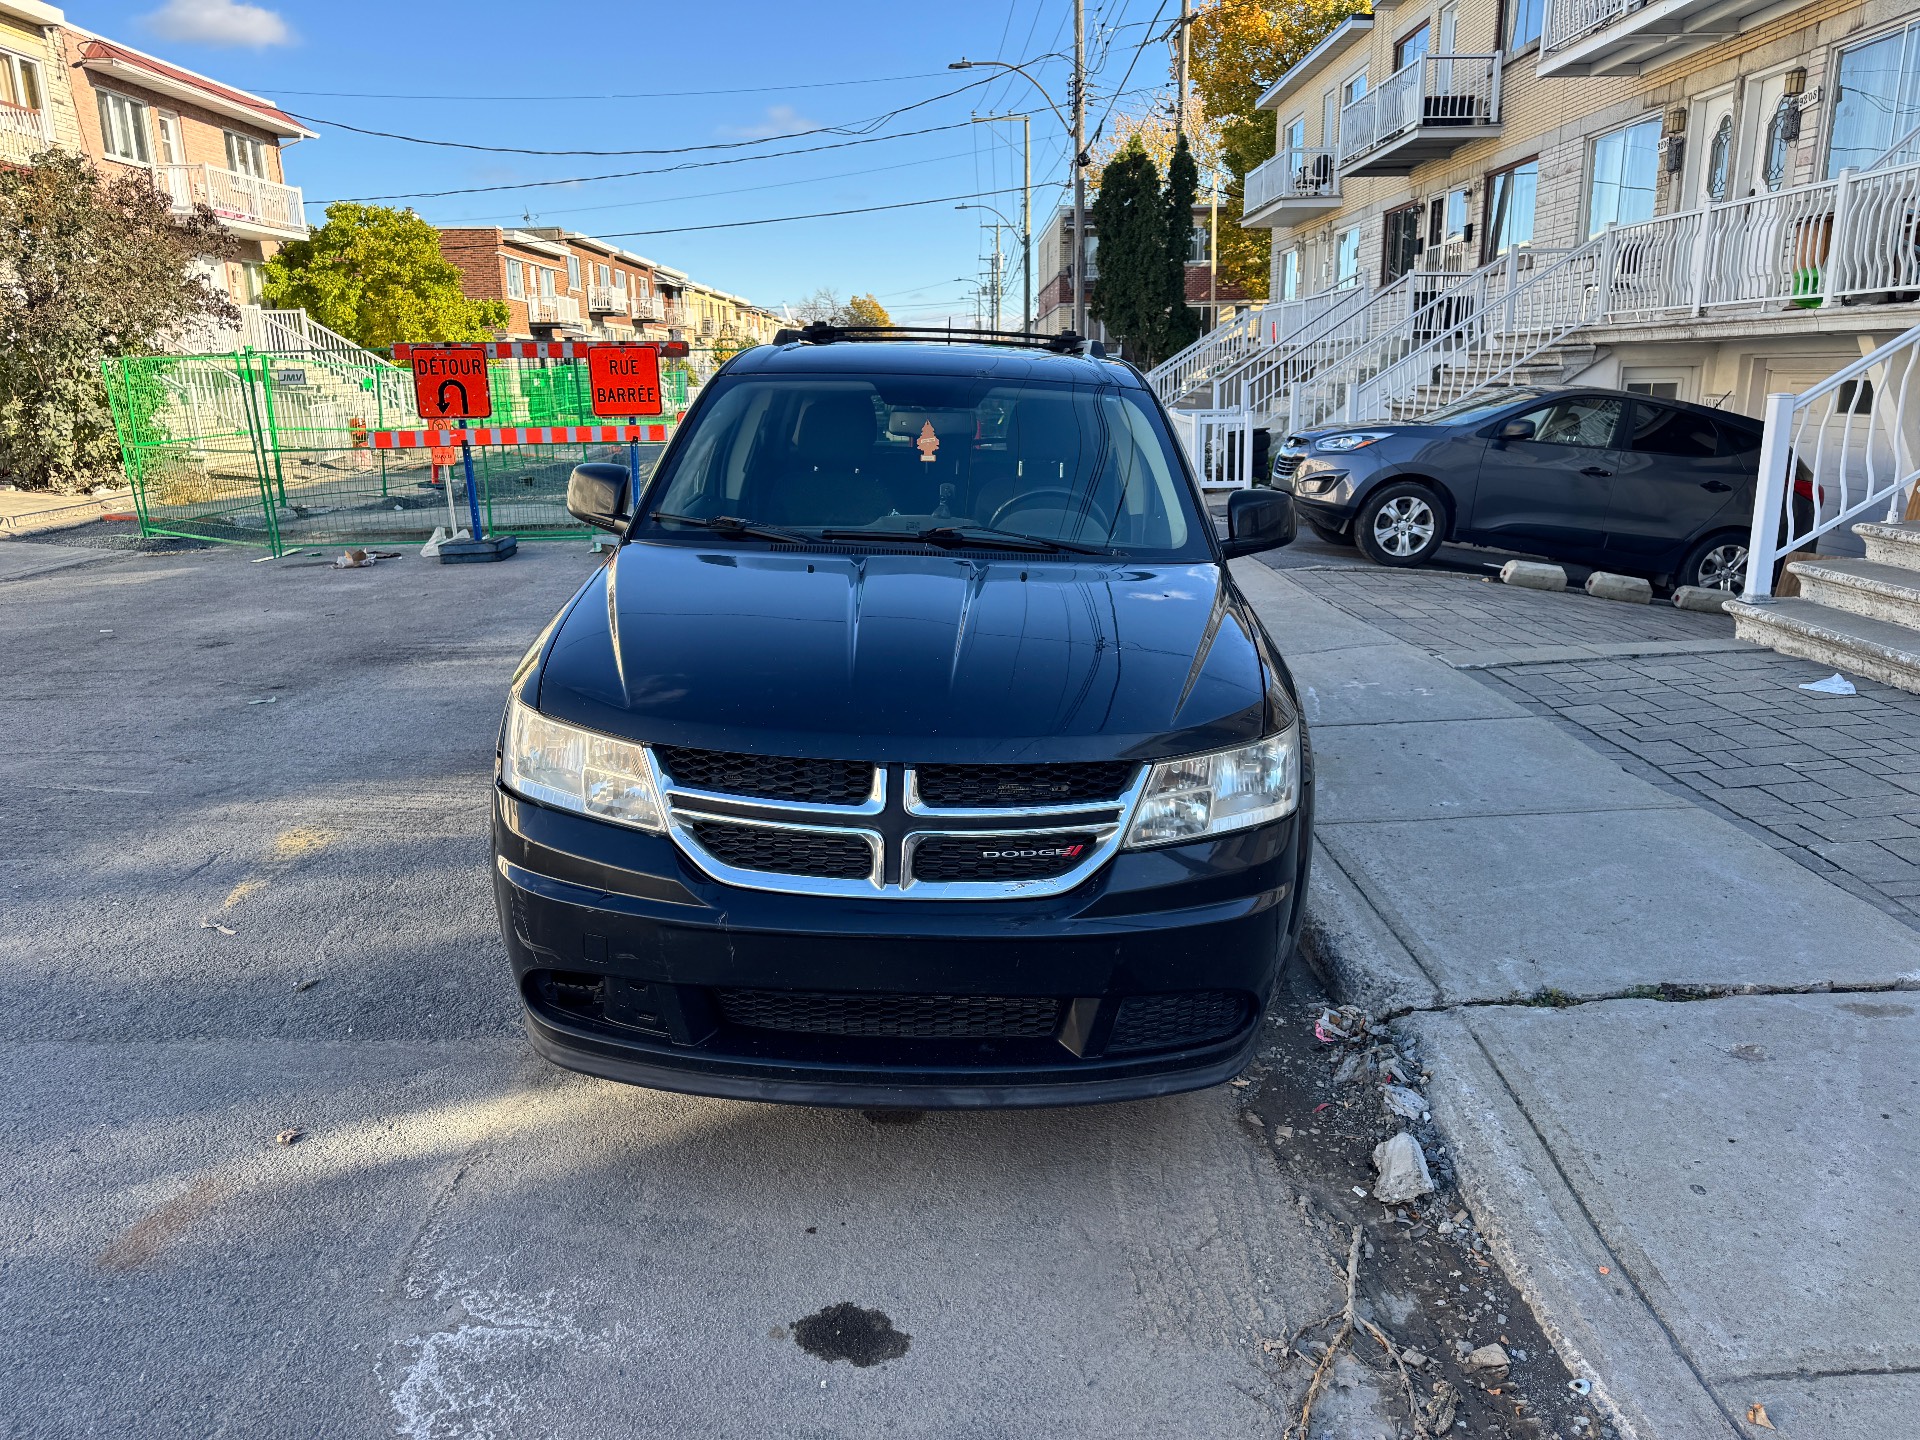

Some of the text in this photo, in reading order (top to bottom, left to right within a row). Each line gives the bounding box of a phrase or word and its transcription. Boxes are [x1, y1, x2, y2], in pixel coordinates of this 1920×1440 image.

[417, 356, 482, 375] DÉTOUR
[609, 359, 639, 375] RUE
[280, 373, 302, 381] JMV
[597, 384, 655, 403] BARRÉE
[982, 848, 1071, 858] DODGE
